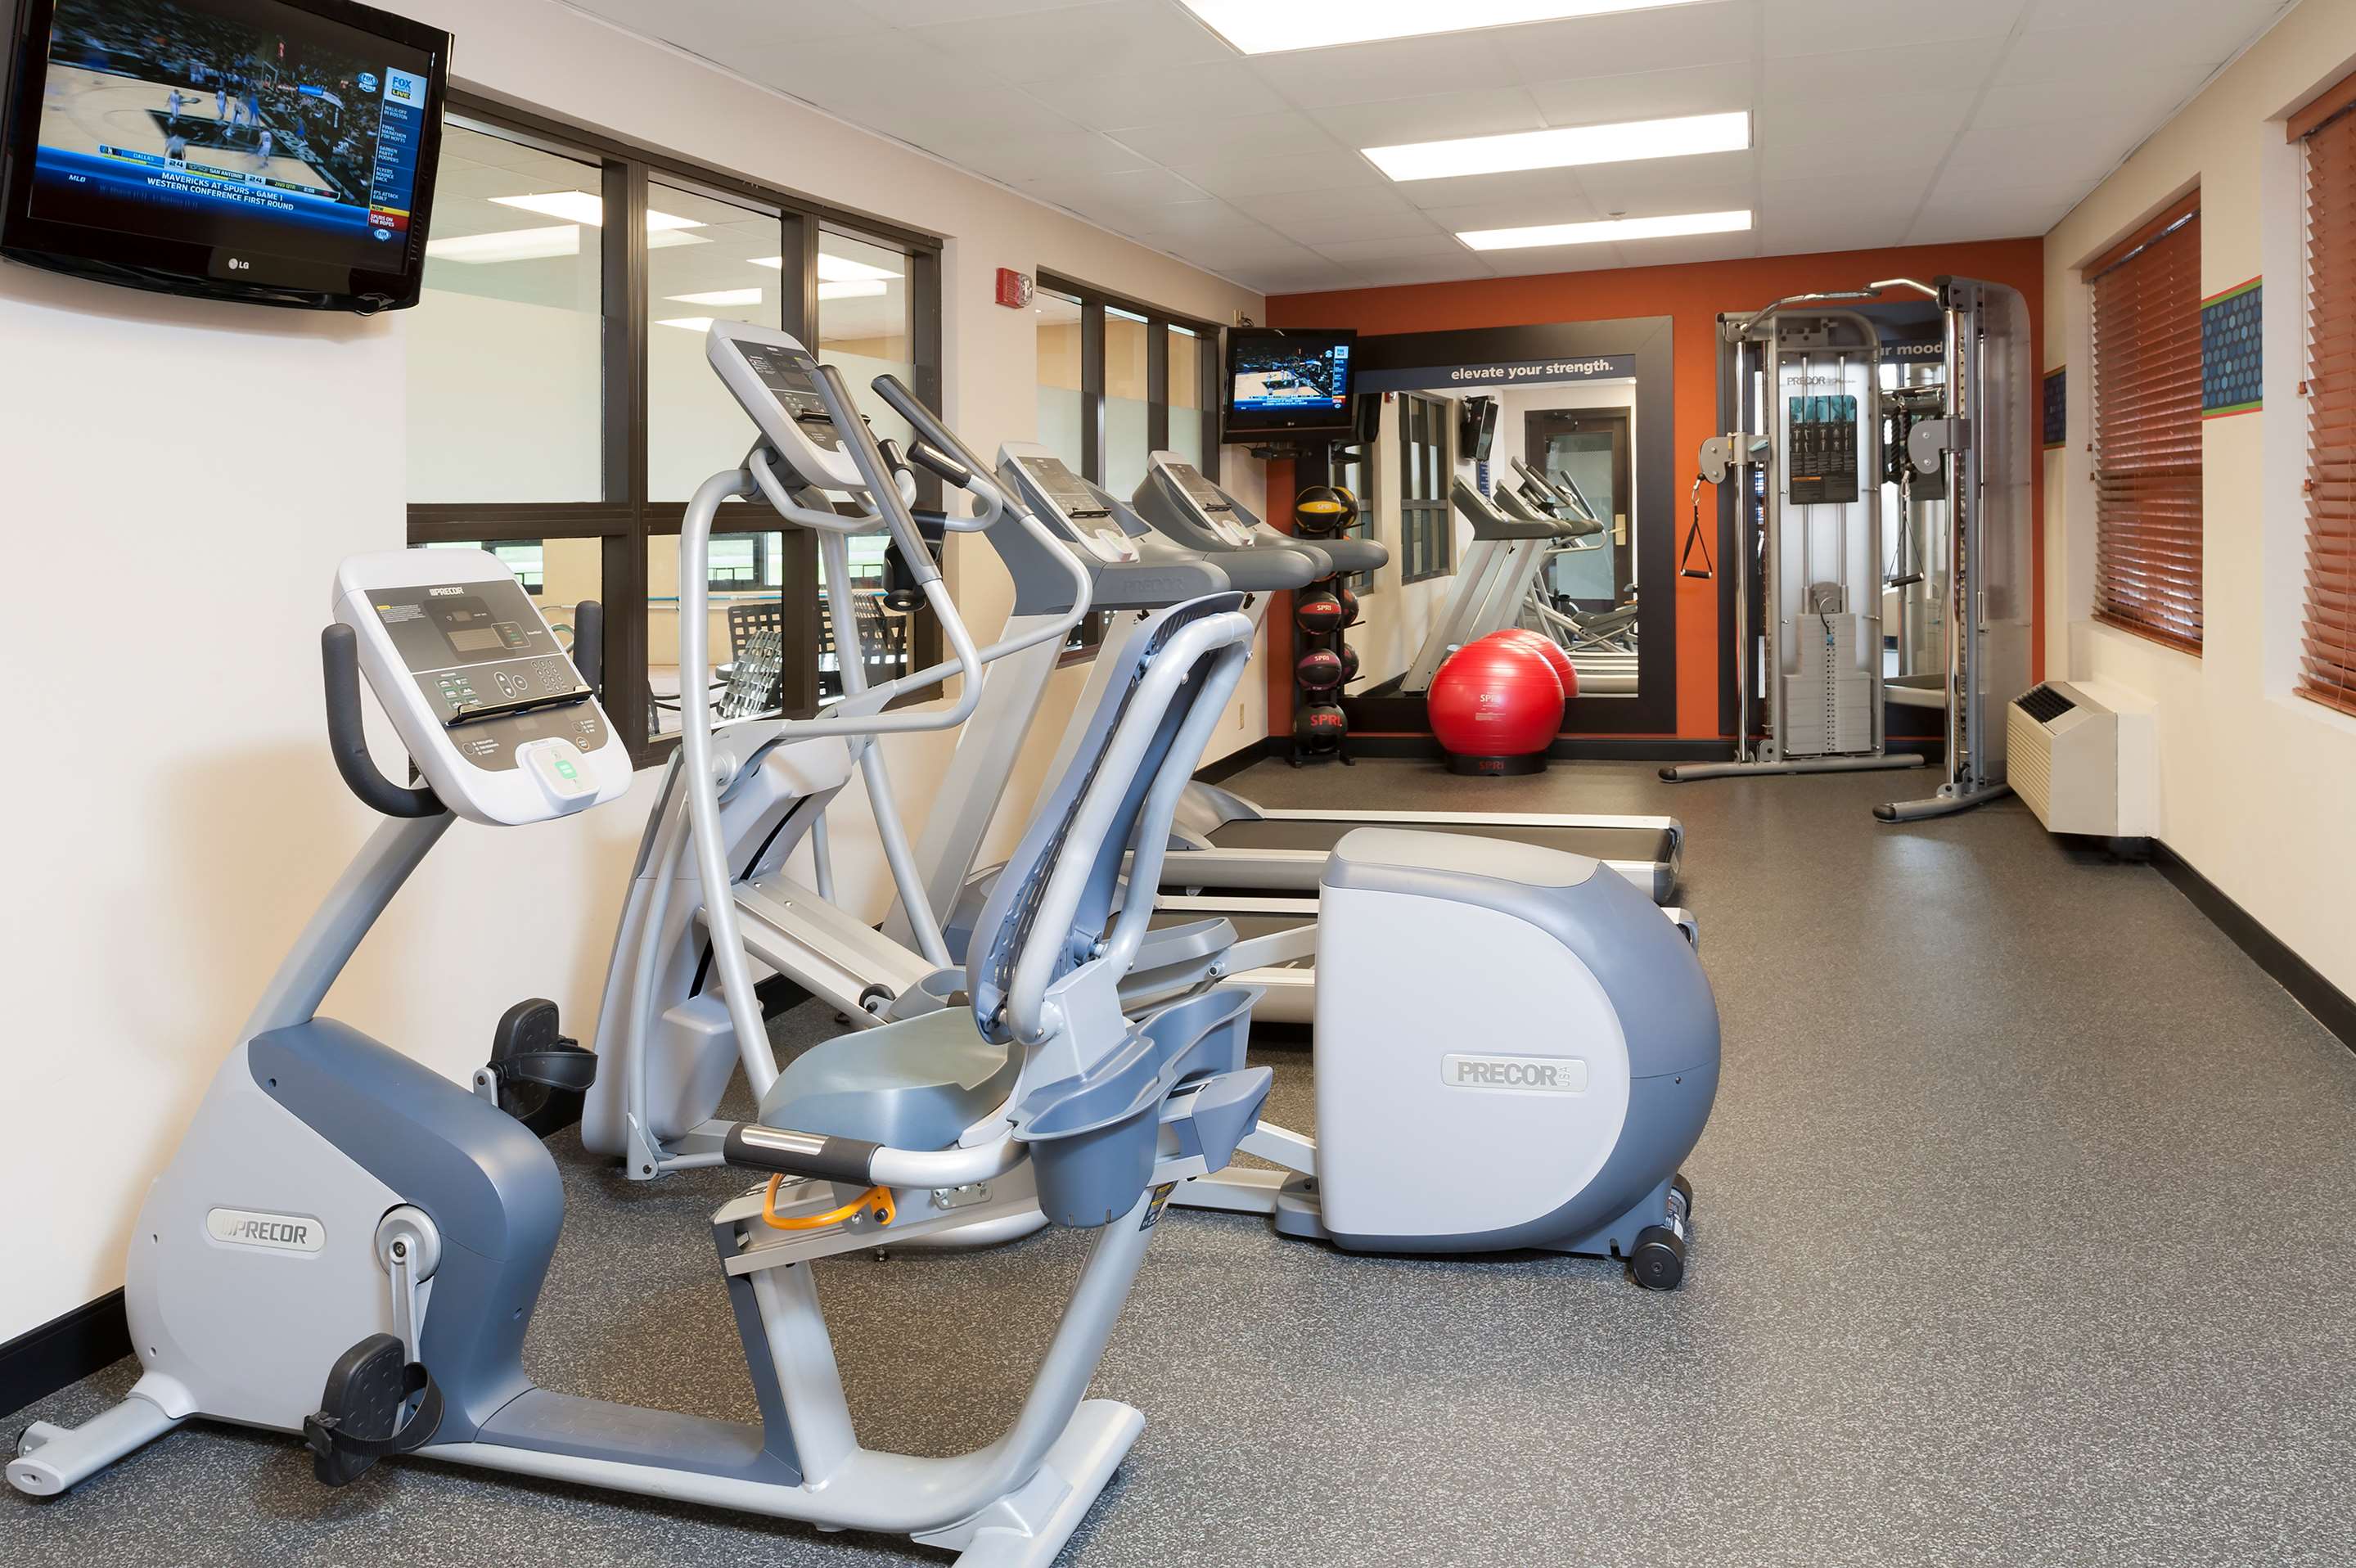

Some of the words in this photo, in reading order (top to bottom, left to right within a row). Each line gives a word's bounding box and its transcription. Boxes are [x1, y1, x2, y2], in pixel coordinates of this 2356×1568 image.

[393, 76, 412, 89] FOX
[392, 90, 410, 99] LIVE
[390, 110, 408, 120] BOSTON
[381, 128, 407, 139] MARATHON
[133, 153, 155, 162] DALLAS
[169, 160, 184, 169] 24
[220, 169, 244, 179] ANTONIO
[376, 166, 394, 174] FLYERS
[68, 174, 86, 182] MLB
[161, 172, 209, 188] MAVERICKS
[211, 182, 222, 190] AT
[223, 183, 250, 195] SPURS
[256, 190, 281, 201] GAME
[147, 178, 188, 192] WESTERN
[190, 186, 242, 202] CONFERENCE
[244, 195, 266, 206] FIRST
[267, 200, 294, 211] ROUND
[238, 261, 250, 269] LG
[1897, 341, 1944, 354] mood
[1451, 367, 1504, 380] elevate
[1508, 365, 1543, 379] your
[1546, 359, 1614, 375] strength.
[1786, 376, 1826, 385] PRECOR
[434, 587, 464, 596] PRECOR
[1309, 714, 1340, 728] SPRI
[1479, 760, 1505, 770] SPRI
[1457, 1061, 1558, 1087] PRECOR
[1558, 1066, 1571, 1087] USA
[232, 1218, 308, 1245] PRECOR
